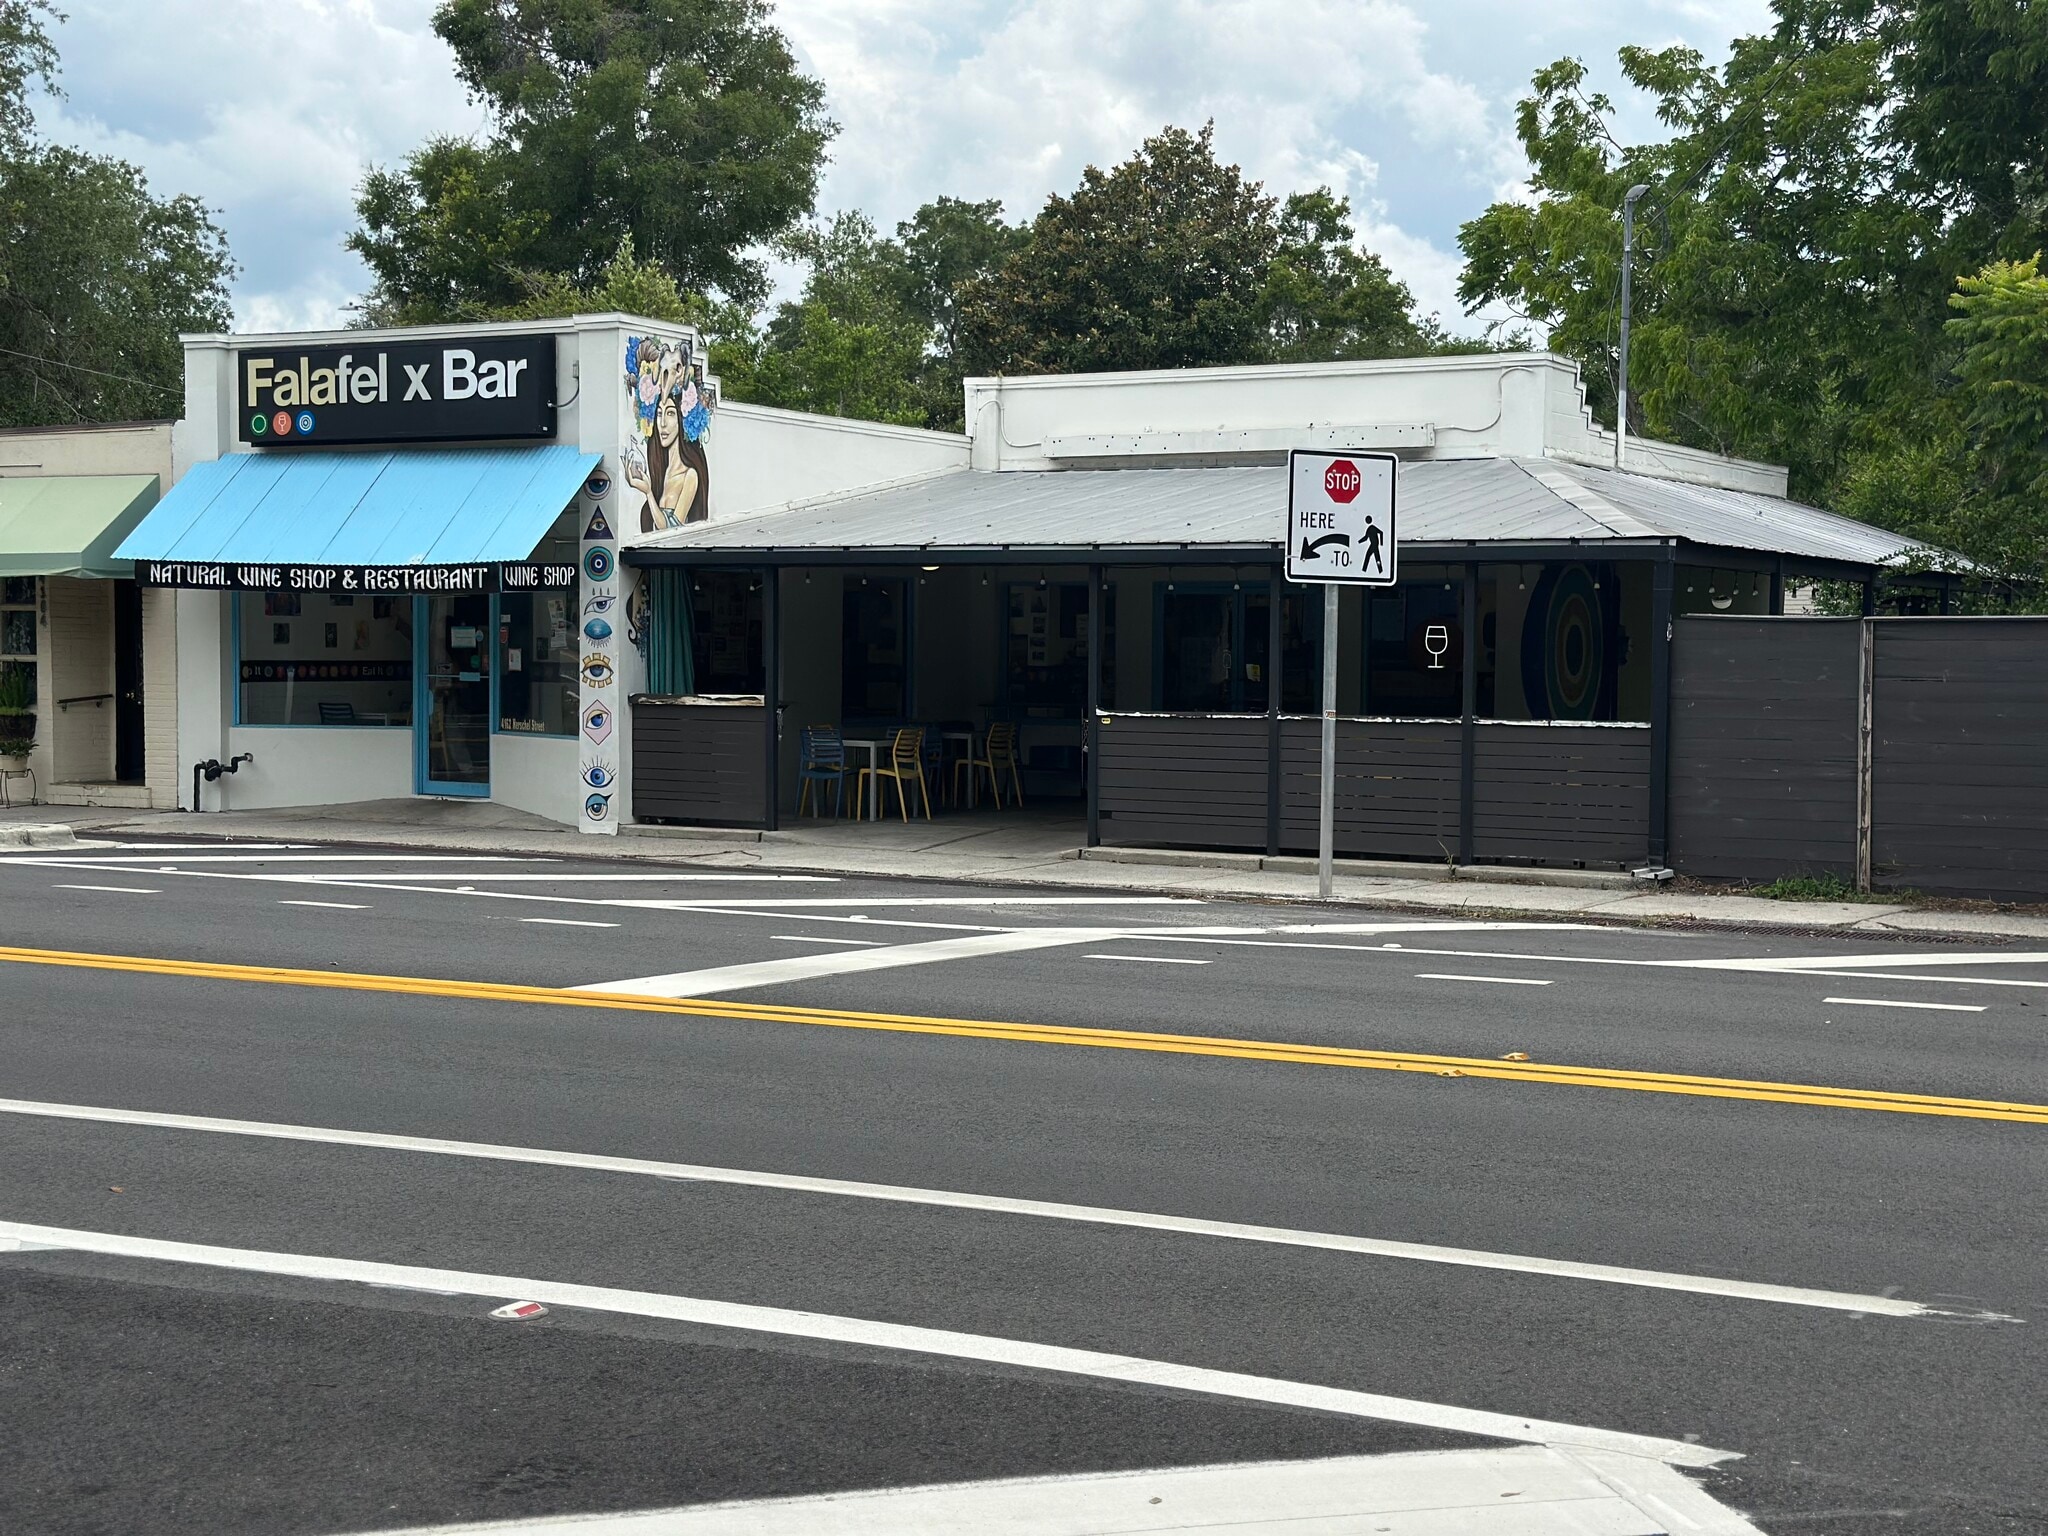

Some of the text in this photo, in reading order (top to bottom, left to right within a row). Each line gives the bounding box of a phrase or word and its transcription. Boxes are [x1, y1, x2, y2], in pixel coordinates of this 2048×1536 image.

[247, 348, 528, 407] Falafel x Bar
[1326, 472, 1359, 491] STOP
[1300, 511, 1335, 529] HERE
[1333, 550, 1350, 567] TO
[150, 564, 488, 590] NATURAL WINE SHOP & RESTAURANT
[505, 566, 575, 587] WINE SHOP
[531, 719, 545, 732] Street
